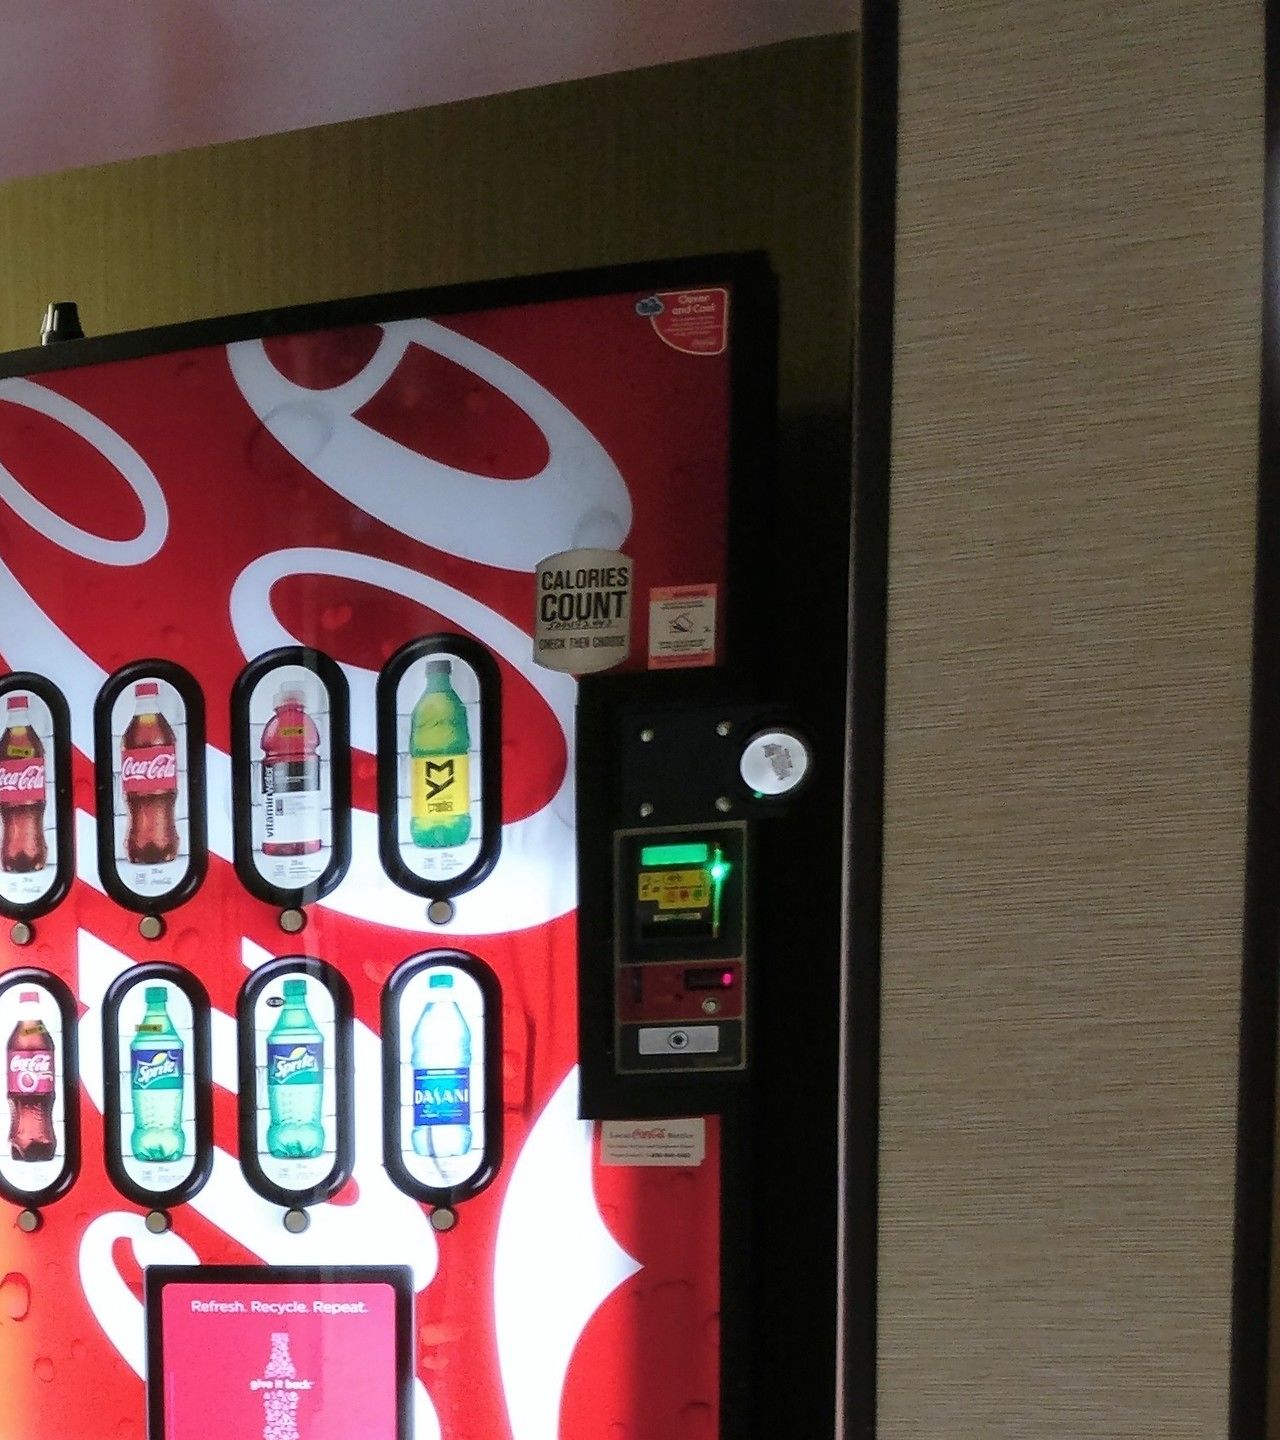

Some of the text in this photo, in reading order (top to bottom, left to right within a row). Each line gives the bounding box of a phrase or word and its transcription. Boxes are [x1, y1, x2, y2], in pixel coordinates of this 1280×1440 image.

[541, 567, 629, 591] CALORIES
[540, 590, 627, 623] COUNT
[138, 1062, 176, 1084] Sprite
[275, 1056, 316, 1079] Sprite
[414, 1087, 469, 1105] DASANI
[191, 1299, 369, 1315] Refresh. Recycle. Repeat.
[249, 1379, 274, 1391] give
[274, 1378, 283, 1389] it
